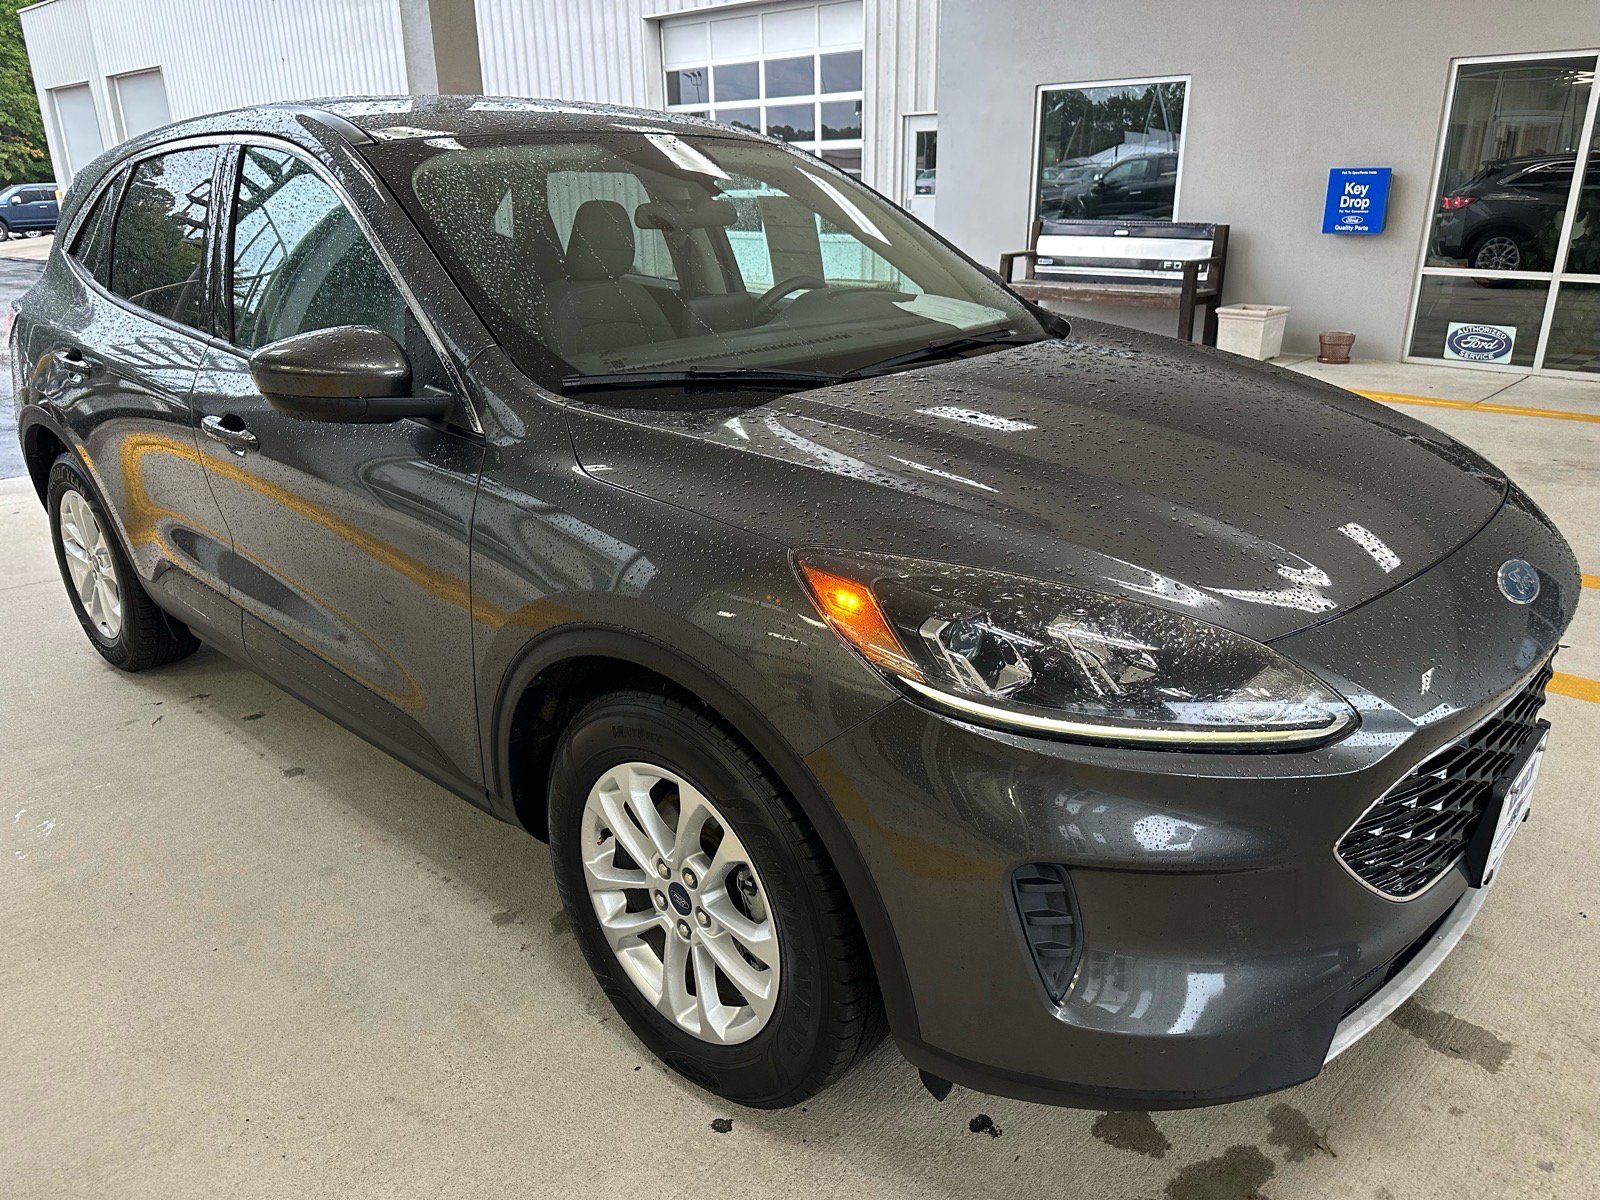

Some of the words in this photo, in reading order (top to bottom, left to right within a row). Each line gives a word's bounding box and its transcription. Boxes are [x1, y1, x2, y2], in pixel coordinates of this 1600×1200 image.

[1344, 182, 1370, 197] Key
[1339, 196, 1370, 210] Drop
[1334, 224, 1354, 232] Quality
[1457, 326, 1507, 340] AUTHORIZED
[1460, 335, 1499, 350] Ford
[1458, 350, 1495, 360] SERVICE
